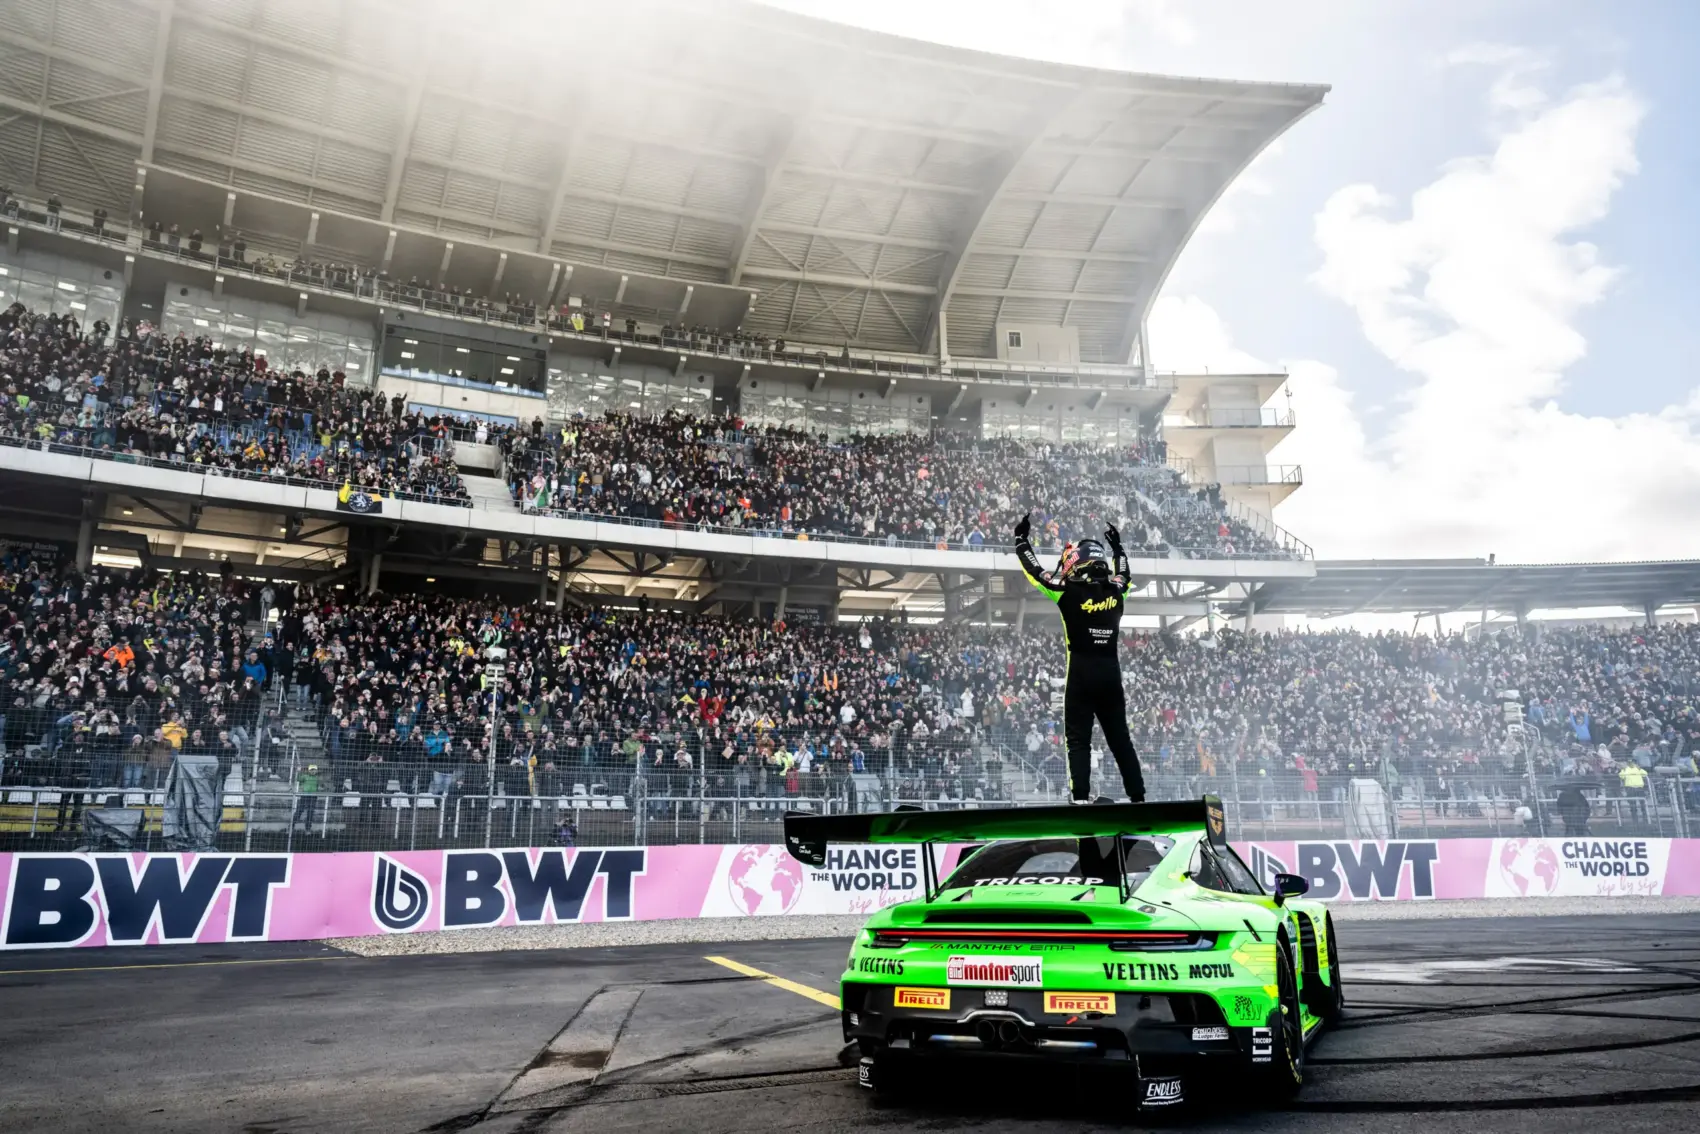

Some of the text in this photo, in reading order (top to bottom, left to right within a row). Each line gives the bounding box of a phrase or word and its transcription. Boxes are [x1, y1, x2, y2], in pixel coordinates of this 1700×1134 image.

[1562, 842, 1648, 859] CHANGE
[812, 849, 916, 870] HANGE
[1297, 843, 1437, 899] BWT
[1564, 861, 1650, 877] THE WORLD
[442, 850, 645, 927] BWT
[811, 872, 917, 891] THE WORLD
[974, 877, 1104, 887] TRICORP
[4, 857, 289, 945] BWT
[860, 957, 904, 975] VELTINS
[1103, 963, 1234, 980] VELTINS MOTUL
[898, 990, 945, 1006] PIRELLI
[1049, 995, 1109, 1010] PIRELLI
[1146, 1080, 1181, 1097] ENDLESS
